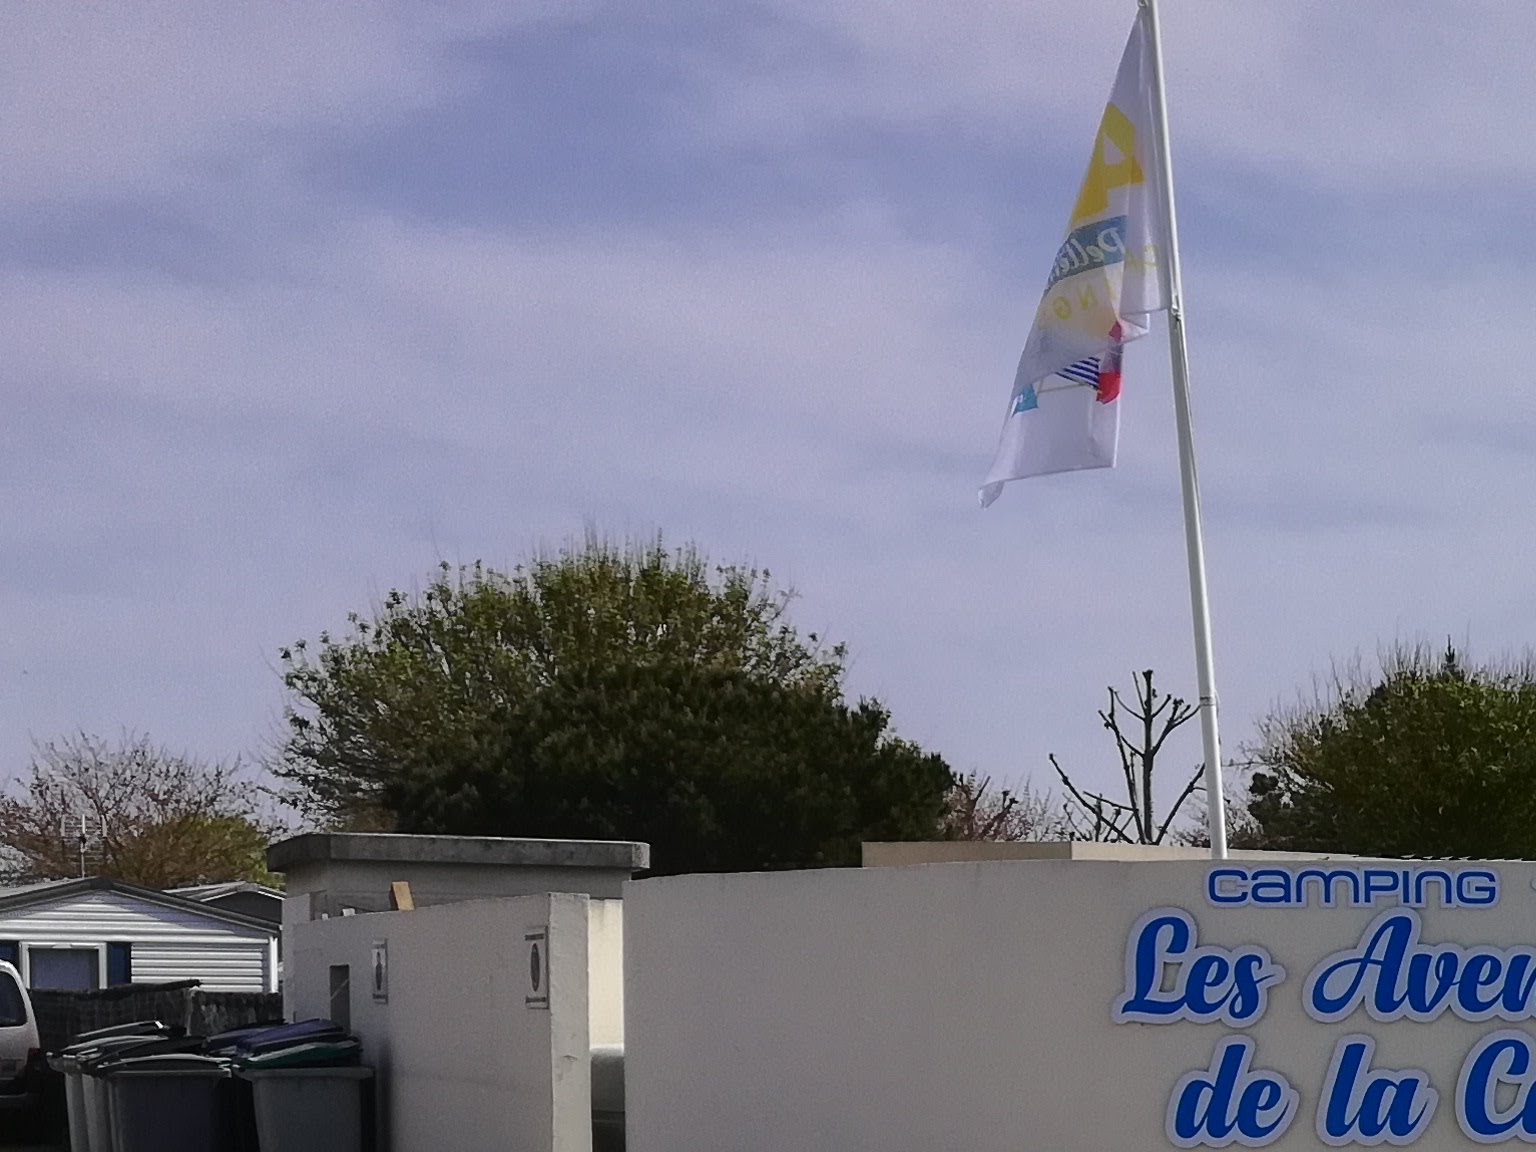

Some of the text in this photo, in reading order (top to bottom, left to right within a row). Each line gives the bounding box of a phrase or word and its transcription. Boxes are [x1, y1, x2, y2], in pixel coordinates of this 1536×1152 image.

[1121, 915, 1277, 1020] Les
[1174, 1043, 1291, 1139] de
[1325, 1043, 1428, 1138] la
